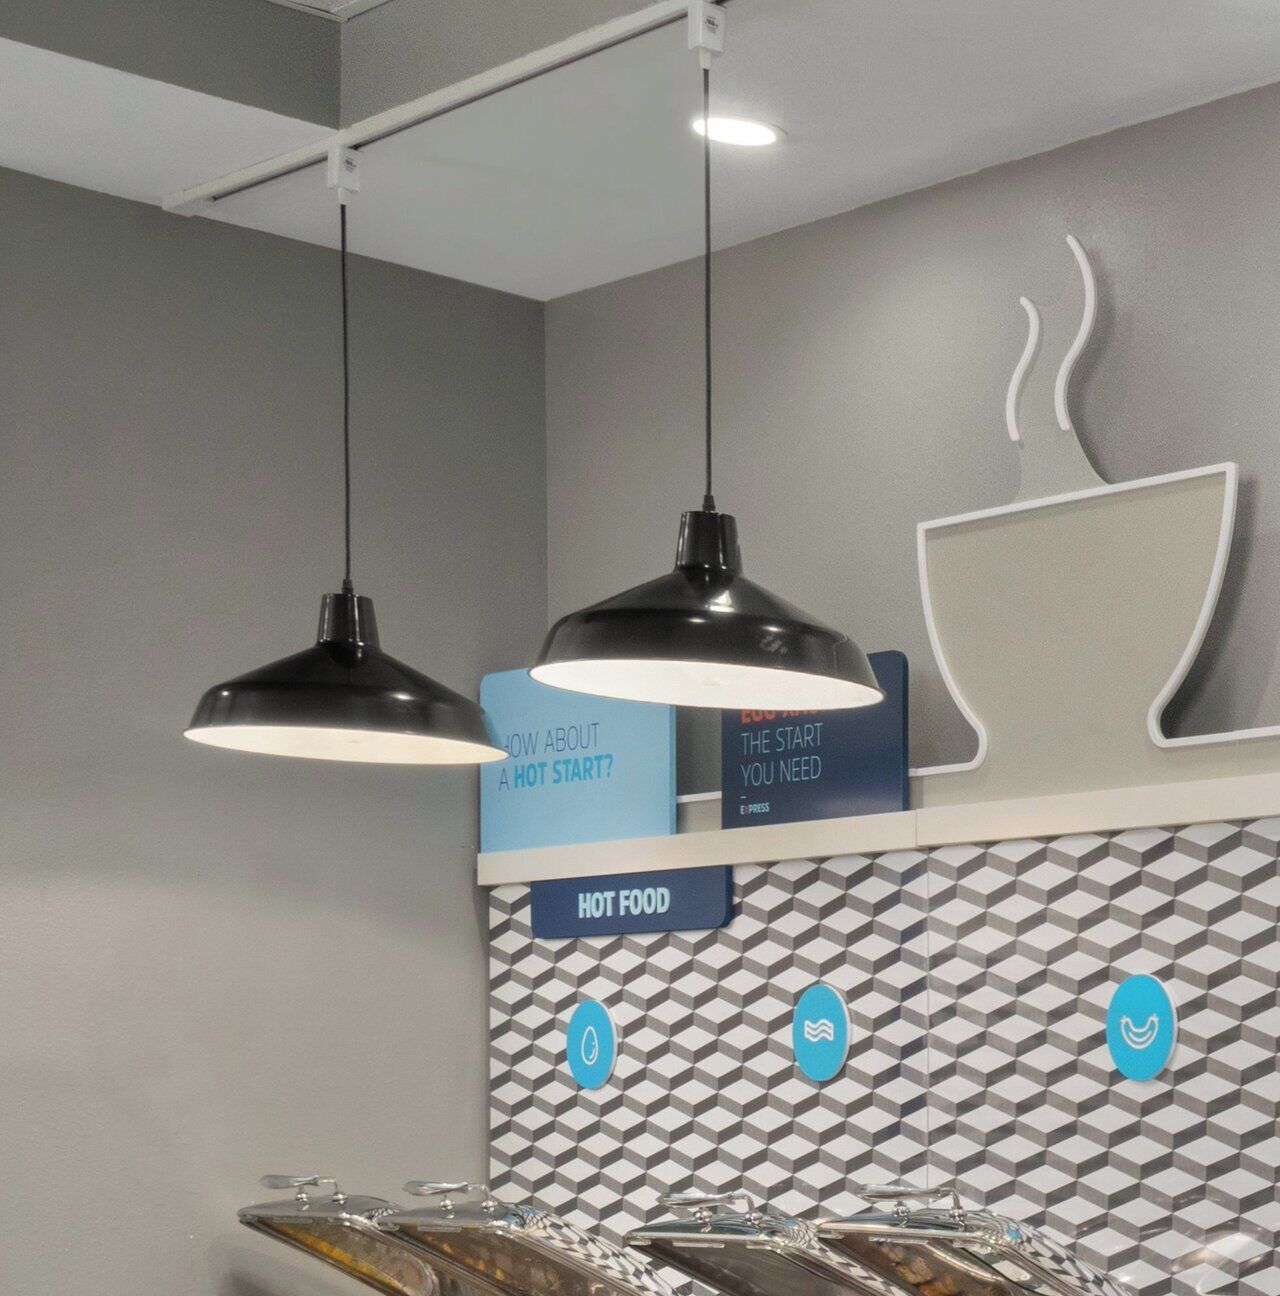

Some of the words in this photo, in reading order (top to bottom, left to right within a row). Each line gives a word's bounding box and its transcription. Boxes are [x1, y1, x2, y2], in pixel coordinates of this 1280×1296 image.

[543, 722, 600, 753] ABOUT
[740, 730, 771, 756] THE
[775, 722, 824, 752] START
[498, 767, 510, 791] A
[513, 761, 548, 789] HOT
[551, 753, 615, 785] START?
[740, 761, 774, 787] YOU
[780, 755, 823, 783] NEED
[577, 890, 616, 919] HOT
[618, 887, 671, 917] FOOD
